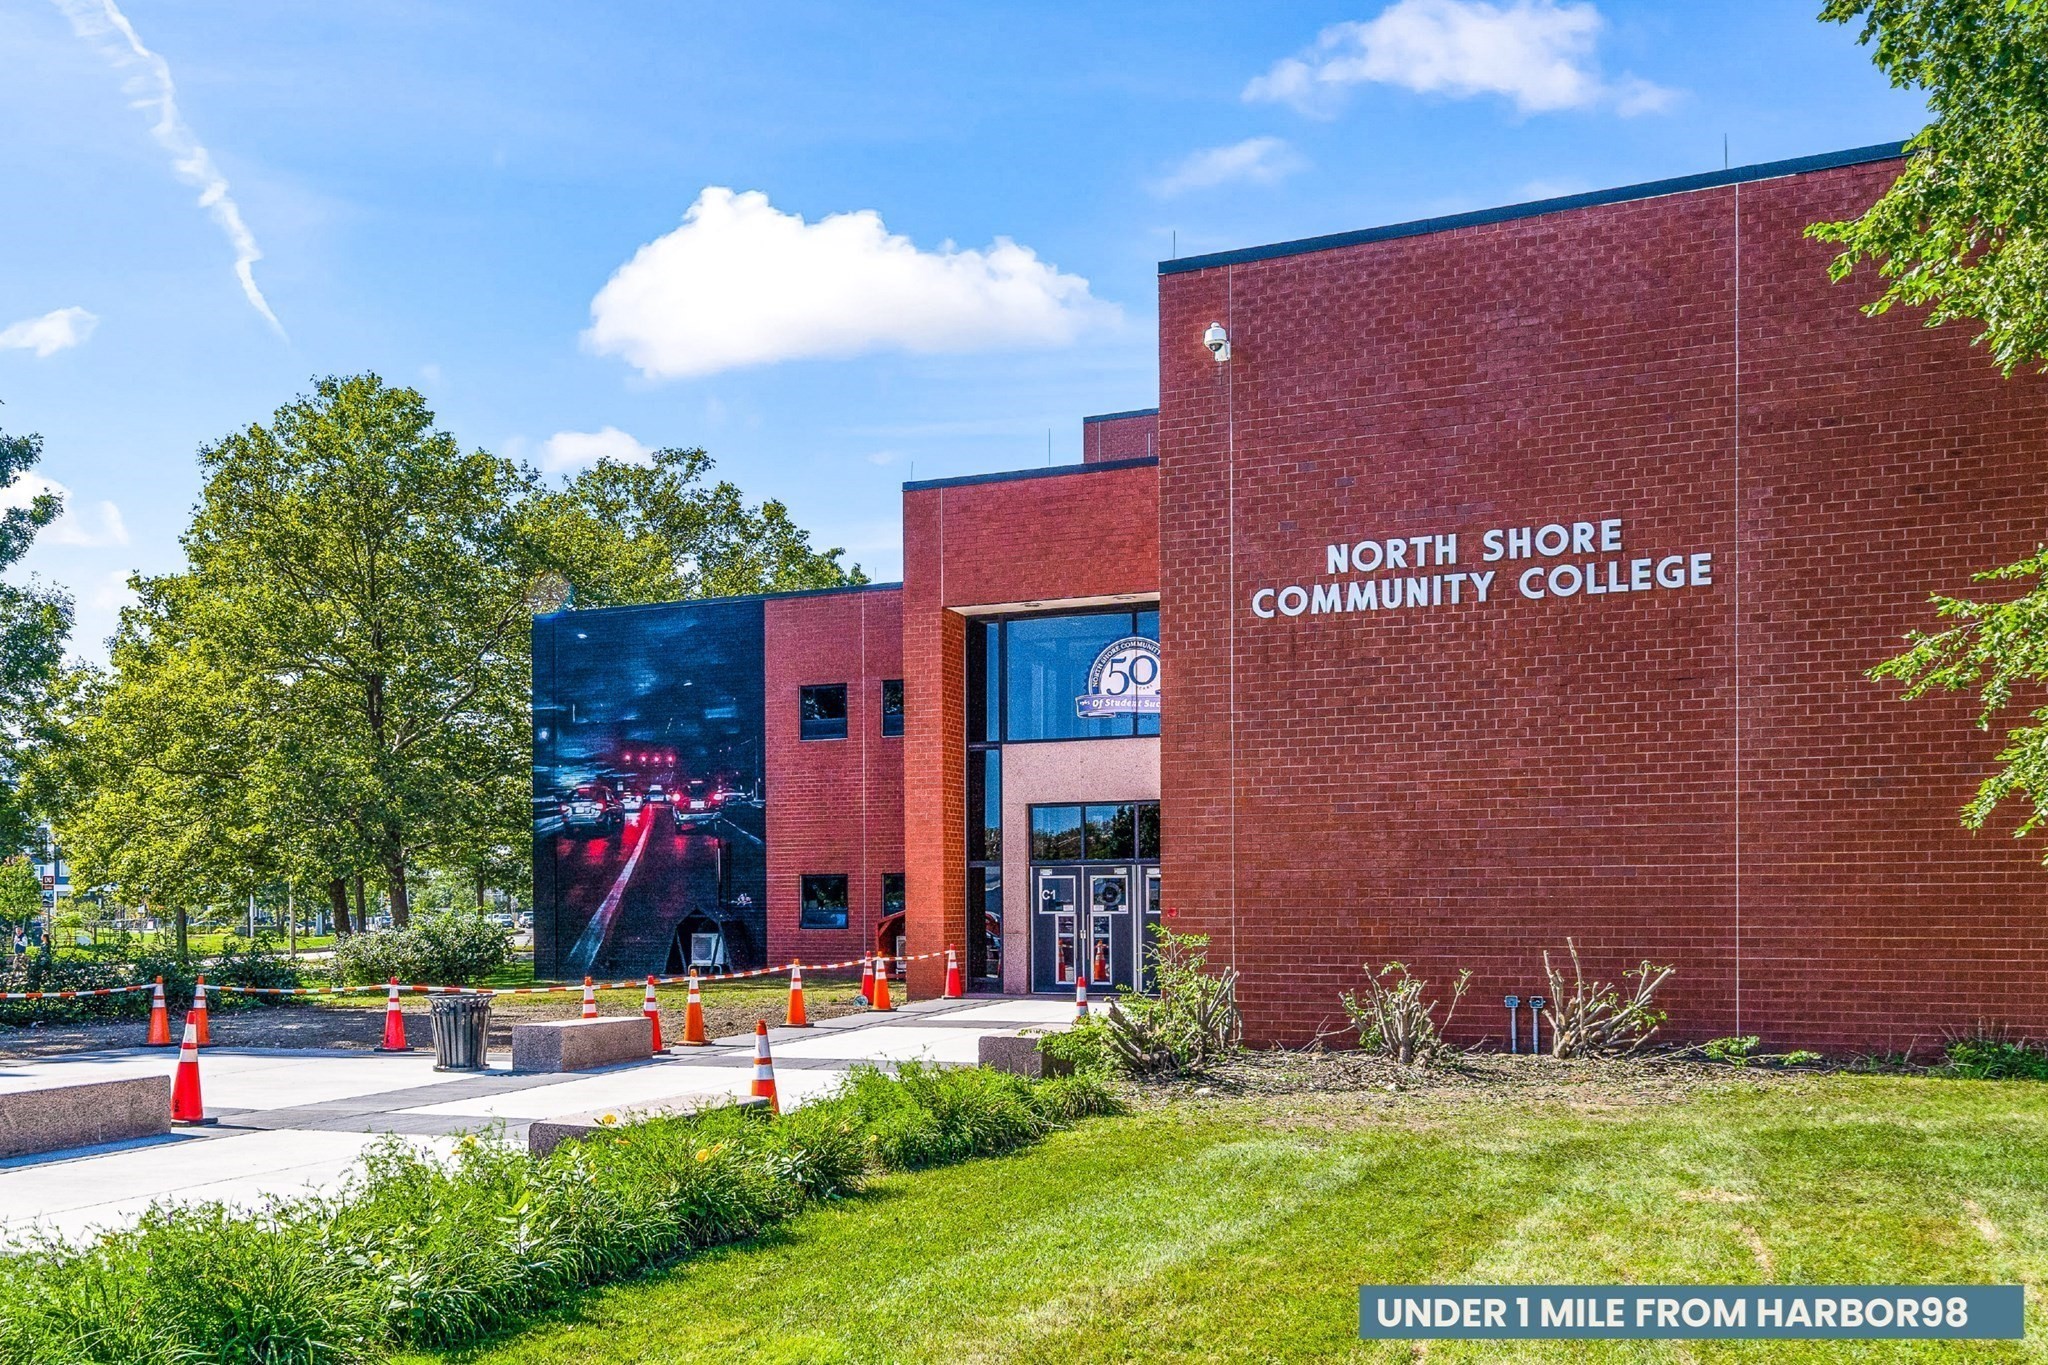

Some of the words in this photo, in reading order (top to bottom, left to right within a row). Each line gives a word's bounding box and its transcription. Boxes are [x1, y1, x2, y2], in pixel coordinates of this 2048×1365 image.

[1327, 533, 1457, 575] NORTH
[1482, 518, 1622, 562] SHORE
[1251, 570, 1496, 619] COMMUNITY
[1518, 552, 1712, 599] COLLEGE
[1092, 663, 1103, 688] NORTH
[1101, 646, 1121, 664] SHORE
[1106, 654, 1158, 696] 50
[1092, 699, 1104, 709] Of
[1105, 698, 1142, 708] Student
[1042, 890, 1056, 900] C1
